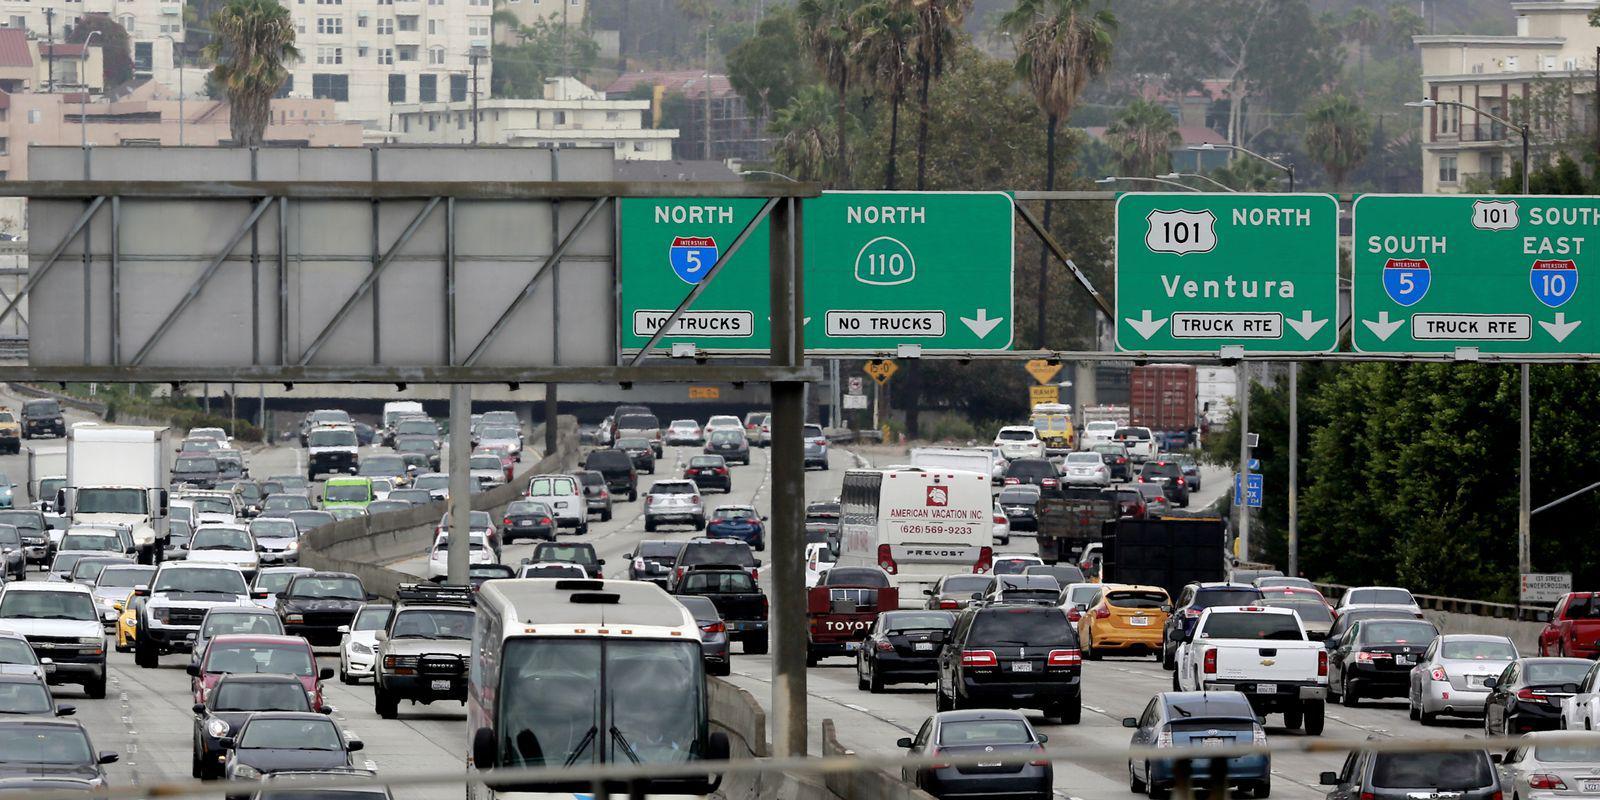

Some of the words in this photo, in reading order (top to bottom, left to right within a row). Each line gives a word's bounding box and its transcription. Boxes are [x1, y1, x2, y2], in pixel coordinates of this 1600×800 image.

[654, 205, 733, 224] NORTH
[847, 205, 926, 224] NORTH
[1232, 208, 1311, 227] NORTH
[1482, 208, 1508, 224] 101
[1163, 221, 1200, 244] 101
[1367, 235, 1447, 254] SOUTH
[1523, 236, 1585, 255] EAST
[686, 250, 702, 273] 5
[868, 253, 904, 277] 110
[1160, 275, 1295, 298] Ventura
[1399, 272, 1415, 295] 5
[1543, 274, 1567, 297] 10
[646, 317, 667, 329] NO
[678, 317, 741, 330] TRUCKS
[839, 317, 860, 330] NO
[869, 317, 932, 330] TRUCKS
[1181, 318, 1235, 332] TRUCK
[1243, 319, 1272, 332] RTE
[1426, 320, 1480, 334] TRUCK
[1488, 321, 1517, 334] RTE
[890, 509, 929, 518] AMERICAN
[931, 509, 968, 519] VACATION
[969, 510, 984, 520] INC.
[906, 549, 965, 557] PREVOST
[825, 621, 873, 631] TOYOT
